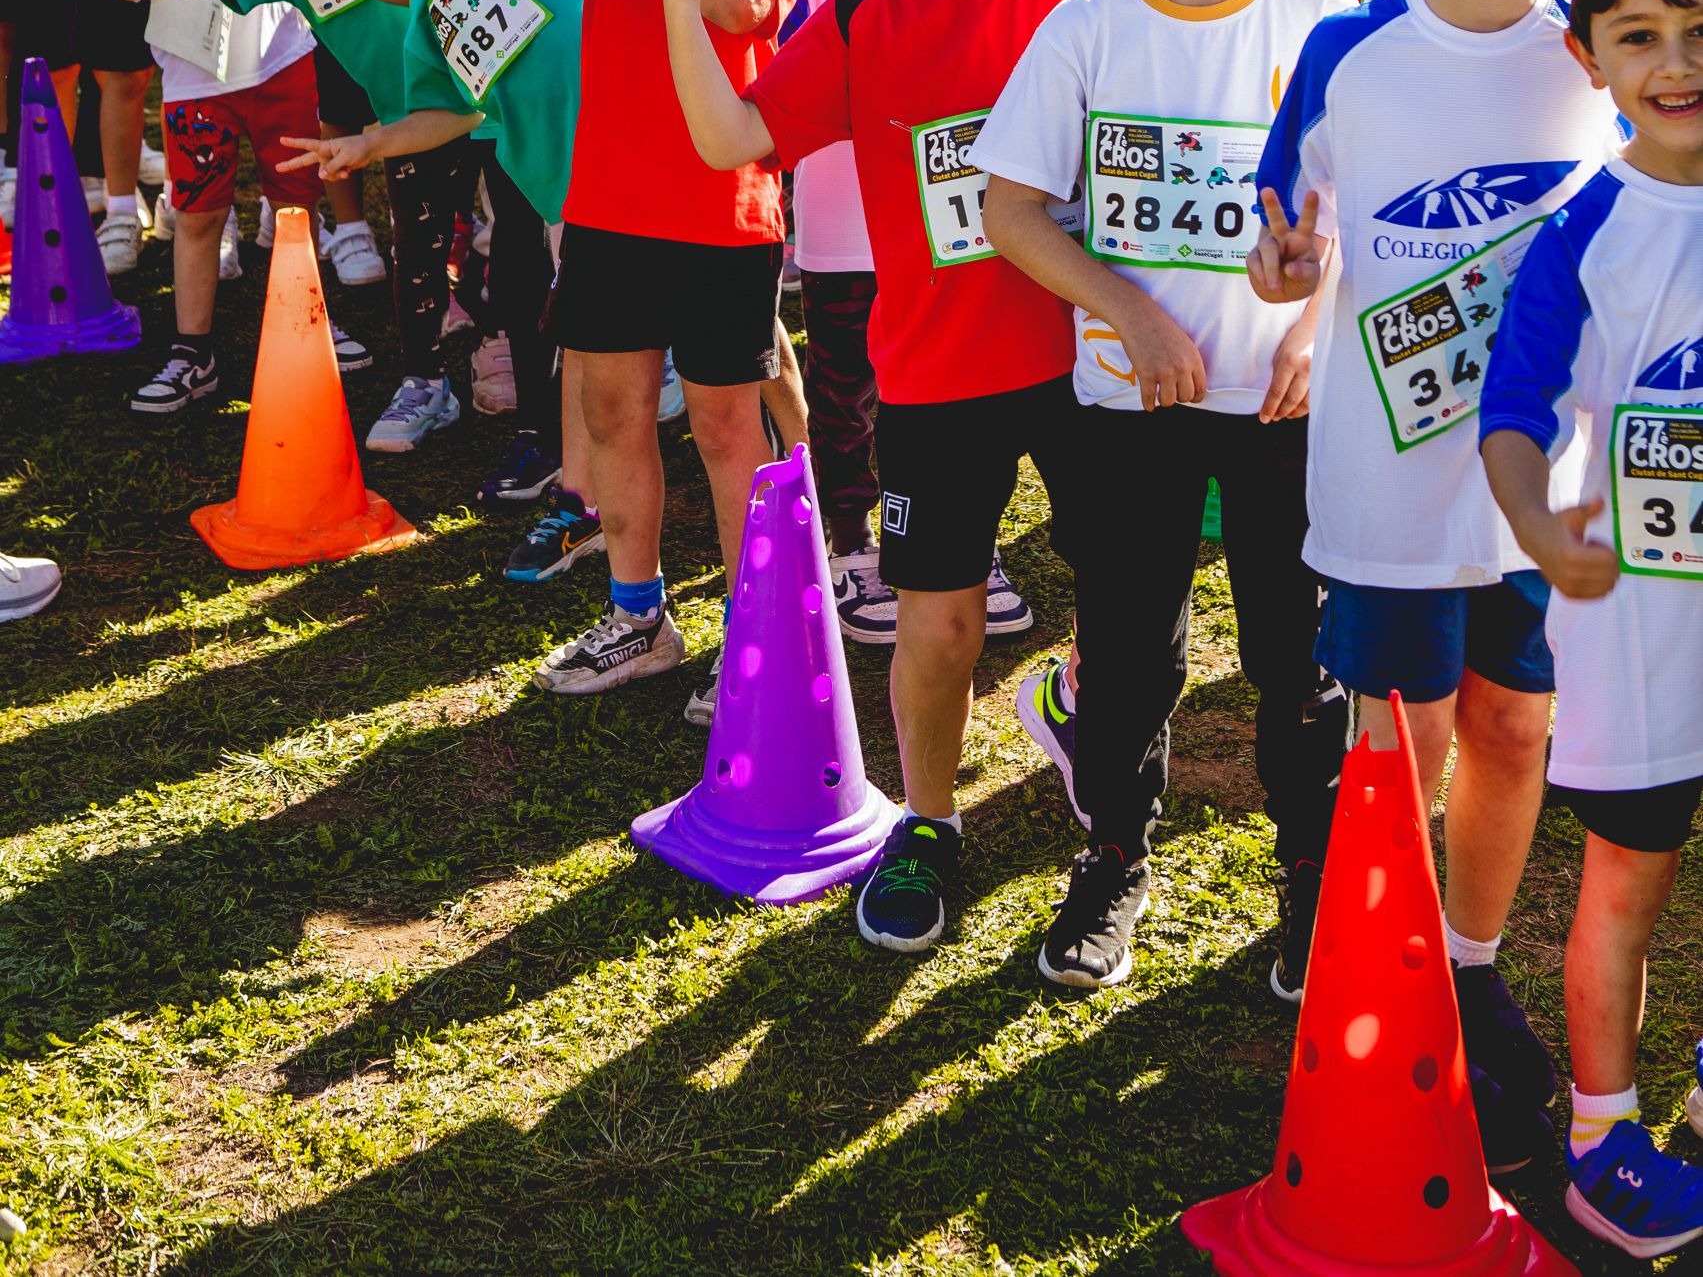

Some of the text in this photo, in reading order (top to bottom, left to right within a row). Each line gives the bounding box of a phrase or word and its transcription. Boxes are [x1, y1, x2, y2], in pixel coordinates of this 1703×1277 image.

[456, 3, 508, 77] 1687
[927, 130, 956, 153] 27è
[1100, 124, 1128, 147] 27è
[929, 144, 974, 174] CRO
[1099, 144, 1159, 171] CROS
[932, 167, 976, 182] Ciutat de Sant
[1100, 166, 1116, 175] Ciutat
[1139, 171, 1158, 179] Cugat
[1105, 192, 1244, 238] 2840
[1373, 235, 1476, 260] COLEGIO
[1383, 305, 1456, 354] CROS
[1629, 419, 1669, 446] 27è
[1629, 443, 1703, 471] CROS
[1630, 468, 1703, 481] Ciutat de Sant Cug
